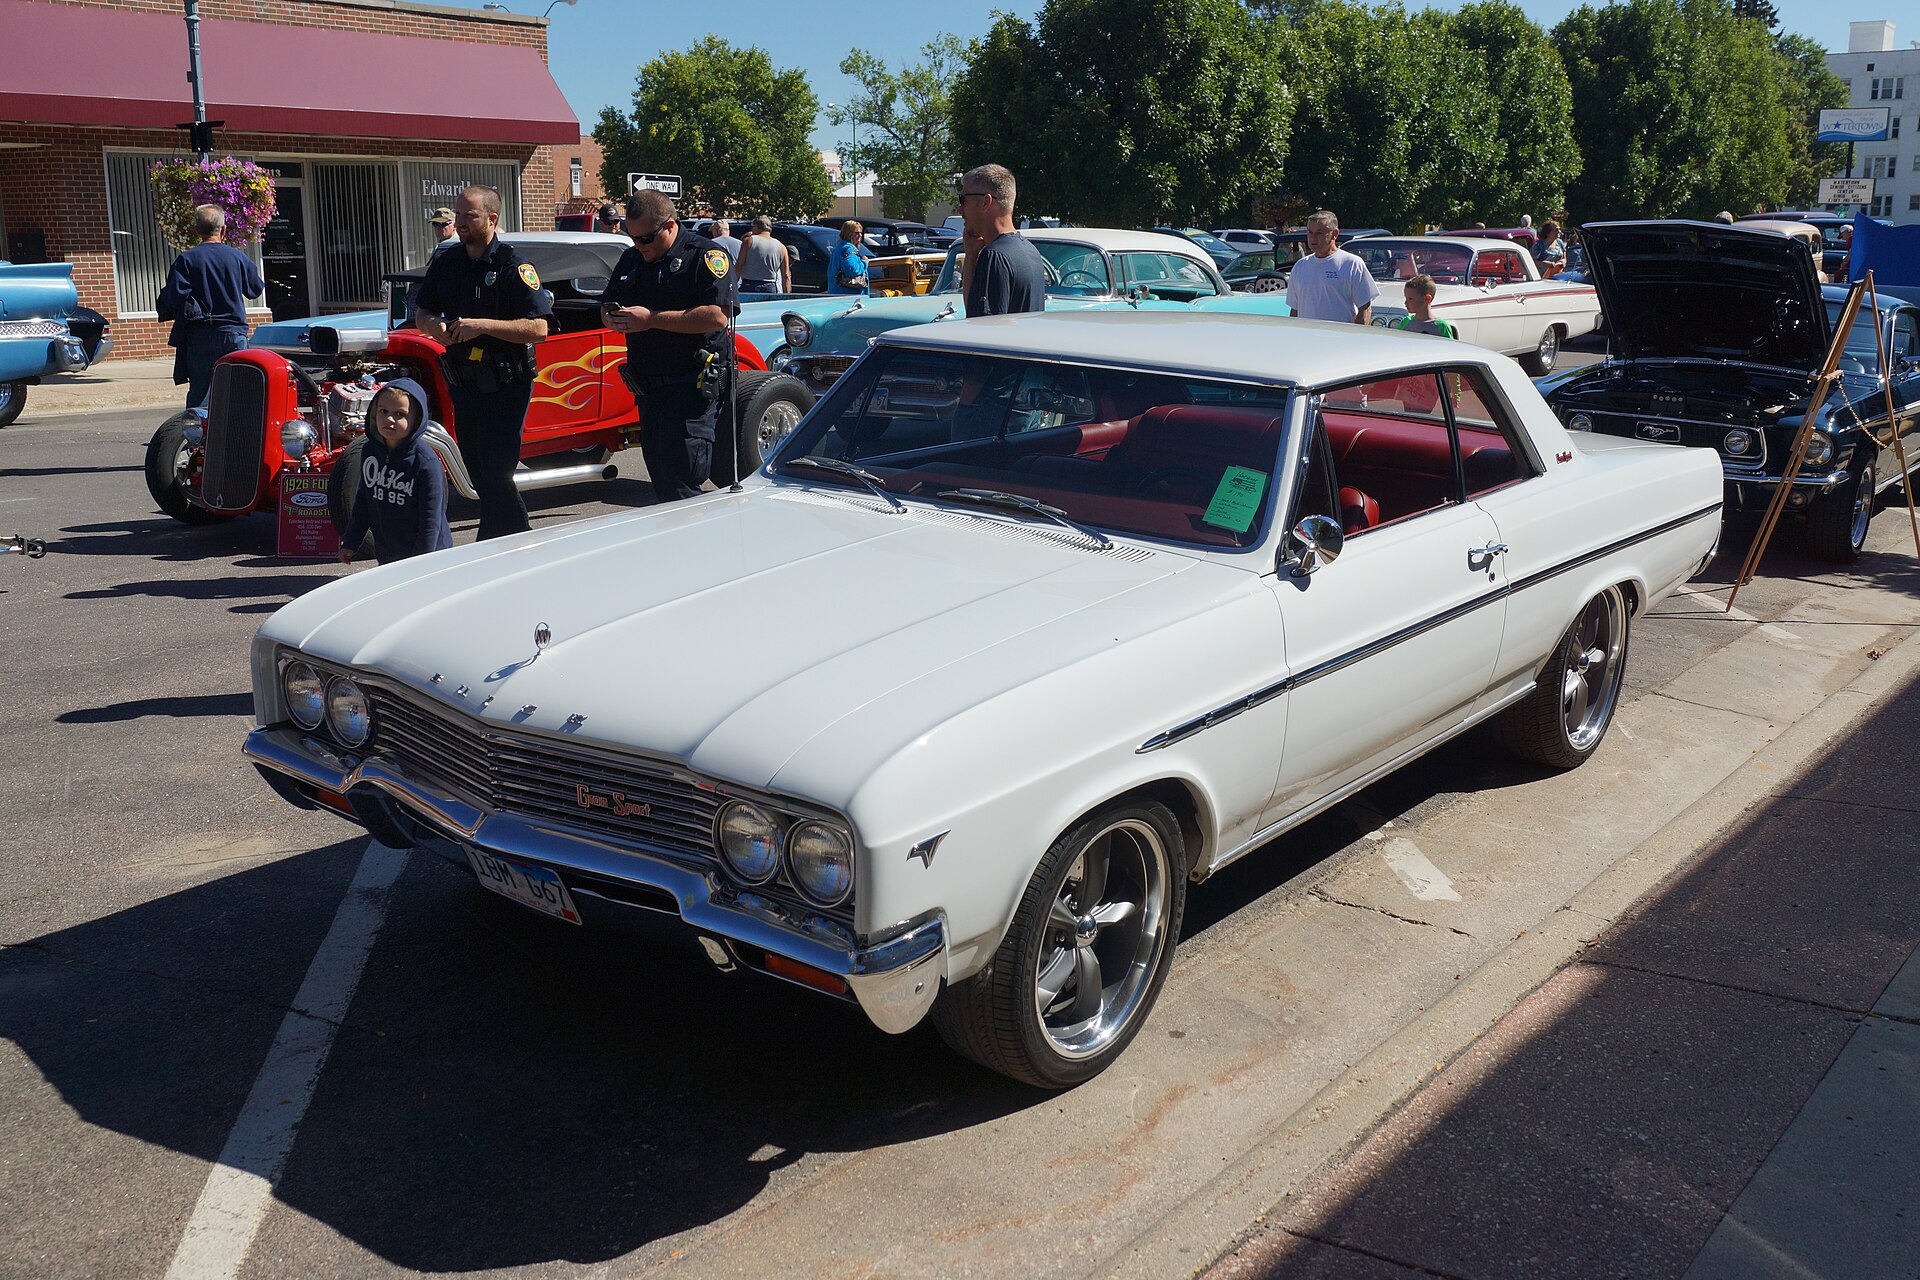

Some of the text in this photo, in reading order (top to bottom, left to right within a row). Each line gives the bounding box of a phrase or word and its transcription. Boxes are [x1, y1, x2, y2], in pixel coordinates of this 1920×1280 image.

[645, 181, 676, 192] ONE WAY
[285, 478, 330, 493] 1926 FO
[296, 493, 327, 504] Ford
[298, 508, 331, 516] ROADST
[613, 792, 651, 817] Sport
